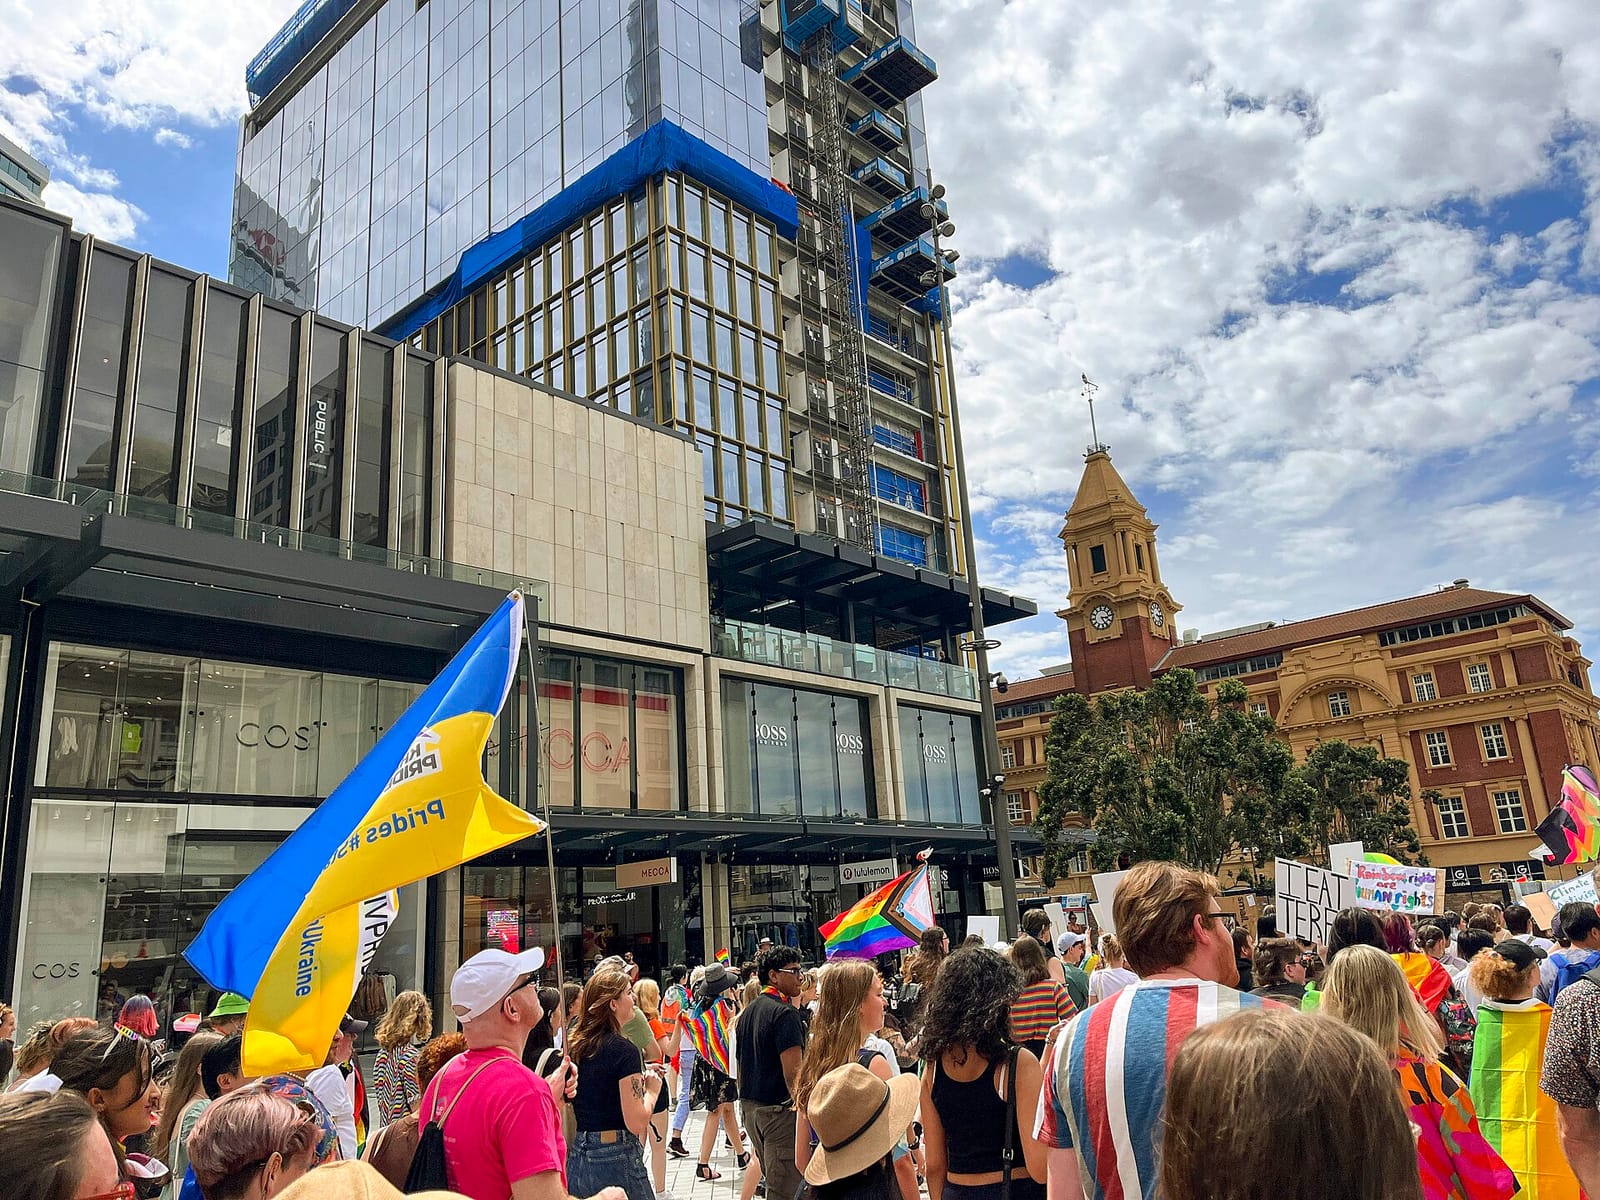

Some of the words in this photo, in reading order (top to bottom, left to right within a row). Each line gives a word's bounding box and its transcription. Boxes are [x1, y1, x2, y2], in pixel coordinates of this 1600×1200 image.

[314, 400, 327, 454] PUBLIC
[235, 722, 310, 751] COS
[924, 744, 946, 759] OSS
[641, 867, 670, 878] MECCA
[853, 866, 890, 878] lululemon
[982, 865, 1001, 876] BOS
[1304, 867, 1350, 911] EAT
[1376, 881, 1397, 890] are
[1551, 879, 1590, 900] Climate
[1394, 890, 1434, 911] rights
[32, 962, 80, 979] COS
